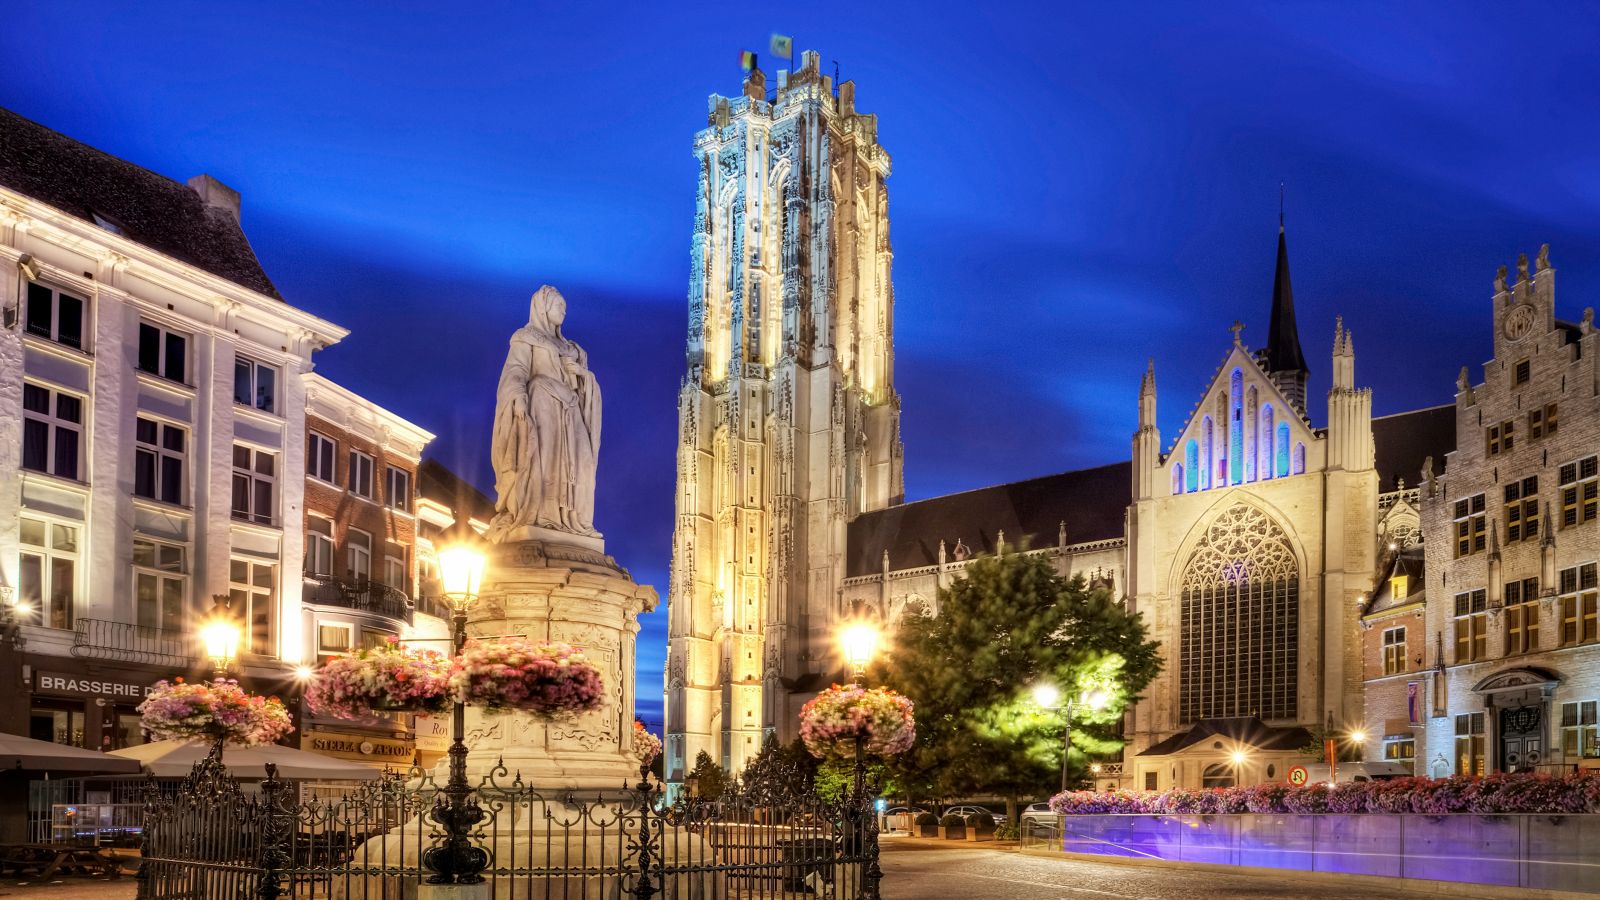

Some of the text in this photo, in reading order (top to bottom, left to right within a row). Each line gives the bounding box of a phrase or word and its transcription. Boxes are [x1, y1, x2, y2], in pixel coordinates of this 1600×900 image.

[41, 676, 140, 697] BRASSERIE
[313, 738, 412, 757] STELLA ARTOIS
